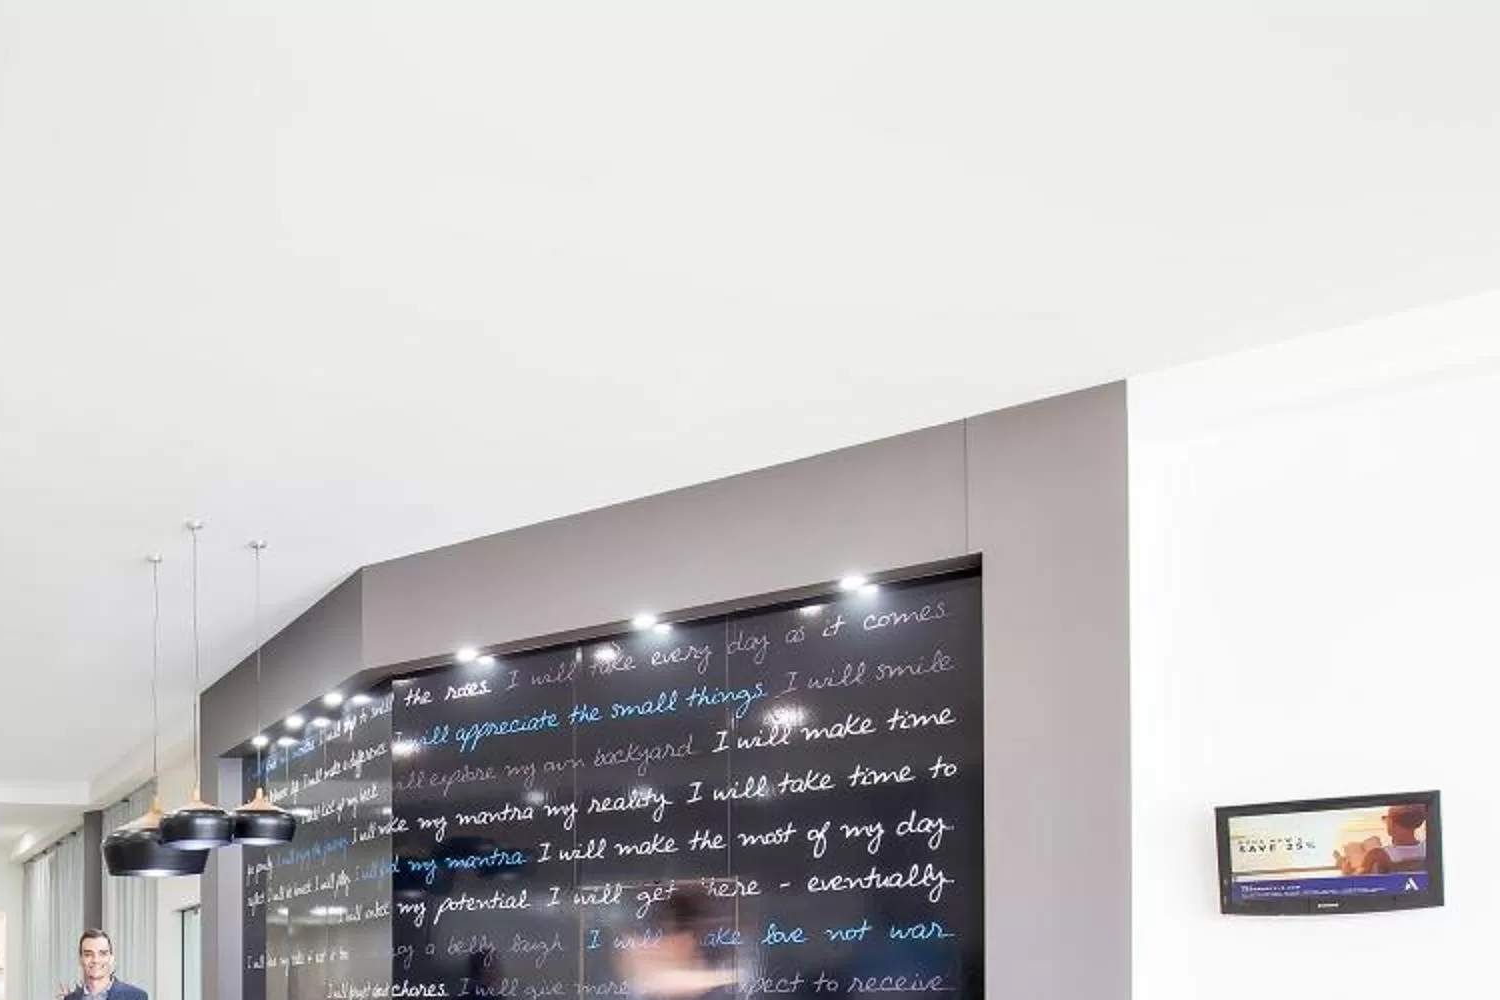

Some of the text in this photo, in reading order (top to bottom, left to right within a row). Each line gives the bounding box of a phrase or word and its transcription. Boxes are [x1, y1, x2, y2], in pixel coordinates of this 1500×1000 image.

[404, 687, 432, 706] the
[505, 669, 519, 690] I
[531, 660, 577, 685] will
[651, 643, 712, 674] every
[726, 628, 770, 664] day
[785, 625, 805, 644] as
[822, 614, 846, 637] it
[863, 602, 946, 631] comes
[454, 709, 560, 752] appreciate
[568, 703, 602, 726] the
[611, 689, 677, 719] small
[686, 680, 768, 720] things
[774, 671, 799, 699] I
[807, 660, 867, 690] will
[874, 648, 956, 682] smile
[429, 765, 497, 797] explore
[504, 762, 536, 788] my
[593, 733, 696, 777] backyard
[711, 730, 729, 753] I
[737, 724, 792, 748] will
[800, 712, 877, 740] make
[886, 707, 957, 731] time
[417, 814, 447, 843] my
[455, 803, 533, 826] mantra
[544, 799, 579, 830] my
[587, 786, 674, 822] reality
[686, 781, 702, 803] I
[713, 776, 768, 800] will
[778, 769, 836, 793] take
[848, 763, 917, 787] time
[928, 755, 957, 779] to
[408, 858, 438, 885] my
[444, 847, 528, 869] mantra
[537, 842, 551, 863] I
[559, 839, 607, 861] will
[613, 833, 680, 856] make
[688, 829, 727, 851] the
[737, 822, 797, 847] most
[807, 820, 831, 858] of
[840, 821, 885, 854] my
[896, 809, 955, 850] day
[397, 901, 427, 927] my
[432, 889, 531, 925] potential
[547, 886, 561, 907] I
[573, 884, 623, 905] will
[636, 879, 680, 919] get
[807, 863, 956, 903] eventually
[391, 978, 449, 997] chores
[457, 977, 471, 996] I
[475, 977, 519, 997] will
[814, 971, 839, 993] to
[847, 971, 956, 994] receive
[448, 935, 496, 967] belly
[587, 928, 599, 950] I
[704, 926, 744, 945] ake
[761, 923, 808, 945] love
[826, 919, 873, 942] not
[889, 919, 956, 940] war
